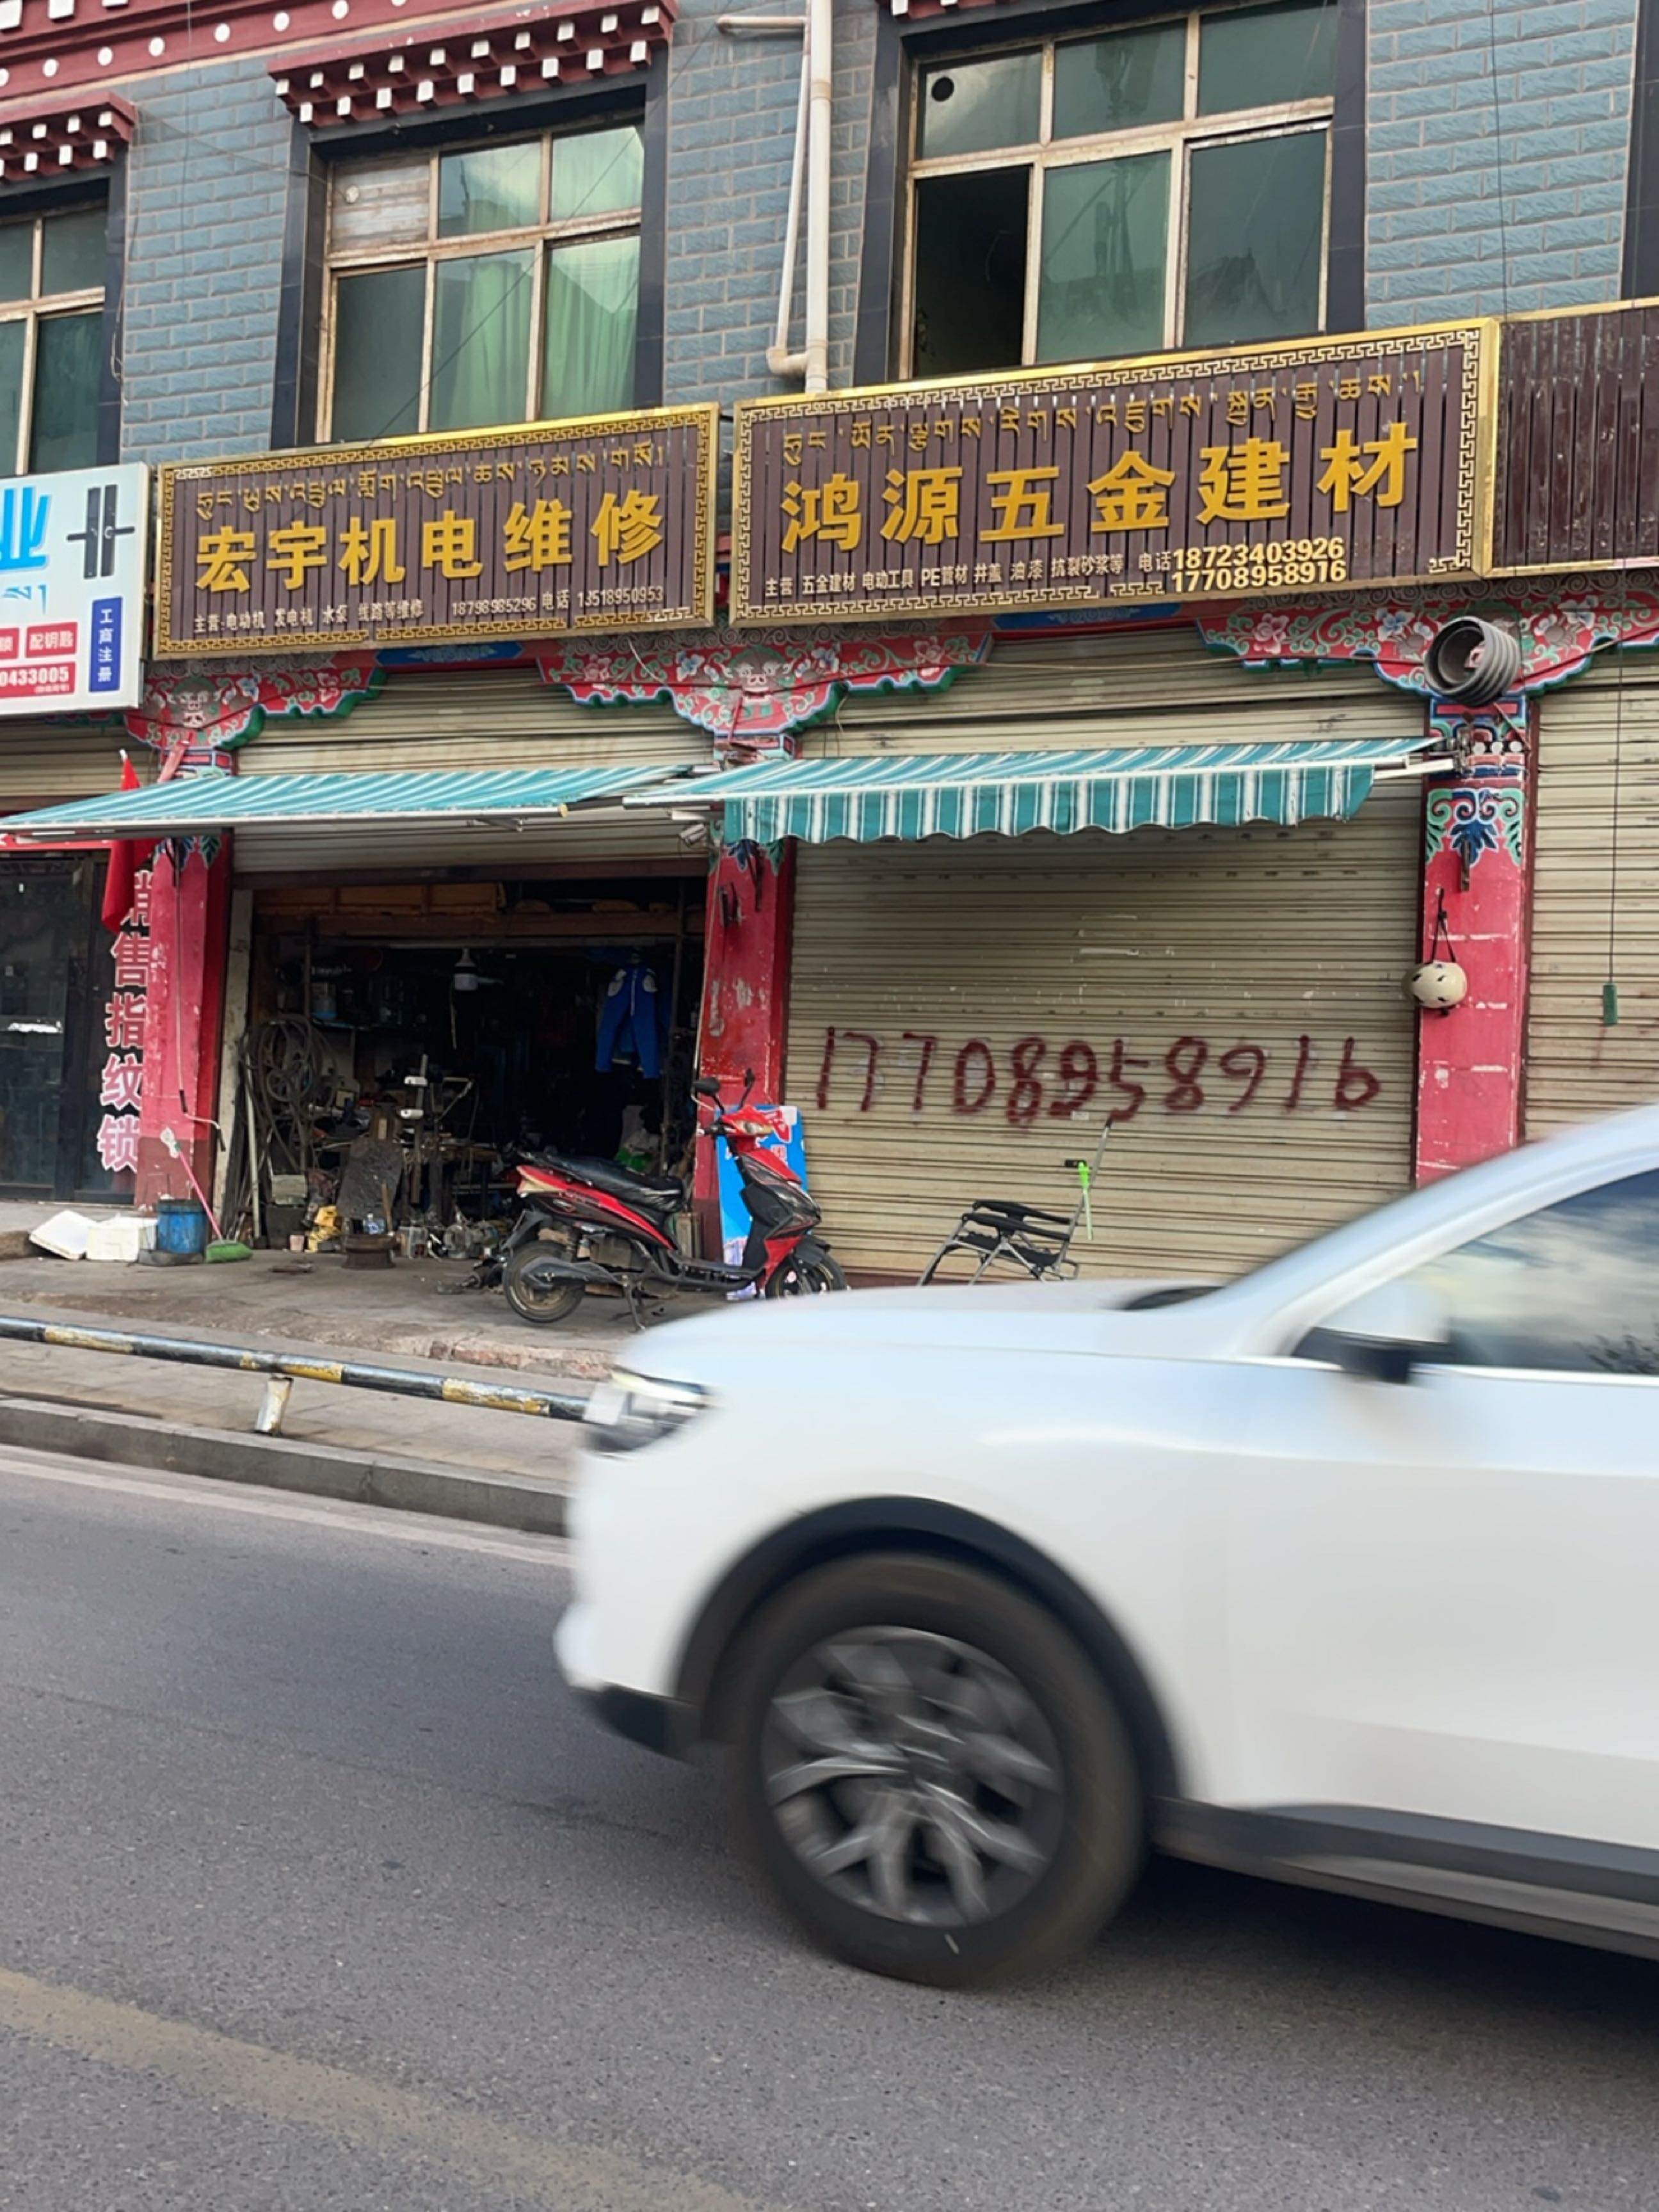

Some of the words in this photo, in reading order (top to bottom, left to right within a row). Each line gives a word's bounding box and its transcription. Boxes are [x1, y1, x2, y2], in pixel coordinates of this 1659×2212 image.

[780, 422, 1418, 554] 鸿源五金建材
[195, 488, 664, 593] 宏宇机电维修
[765, 576, 793, 597] 主营
[802, 571, 856, 595] 五金建材
[862, 568, 914, 591] 电动工具
[920, 563, 968, 587] PE管材
[974, 562, 1002, 583] 井盖
[1010, 558, 1044, 581] 油漆
[1139, 551, 1172, 573] 电话
[1173, 536, 1345, 571] 18723403926
[1171, 560, 1347, 593] 17708958916
[542, 588, 571, 611] 电话
[577, 585, 664, 607] 13518950953
[816, 1025, 1381, 1125] 17708958916
